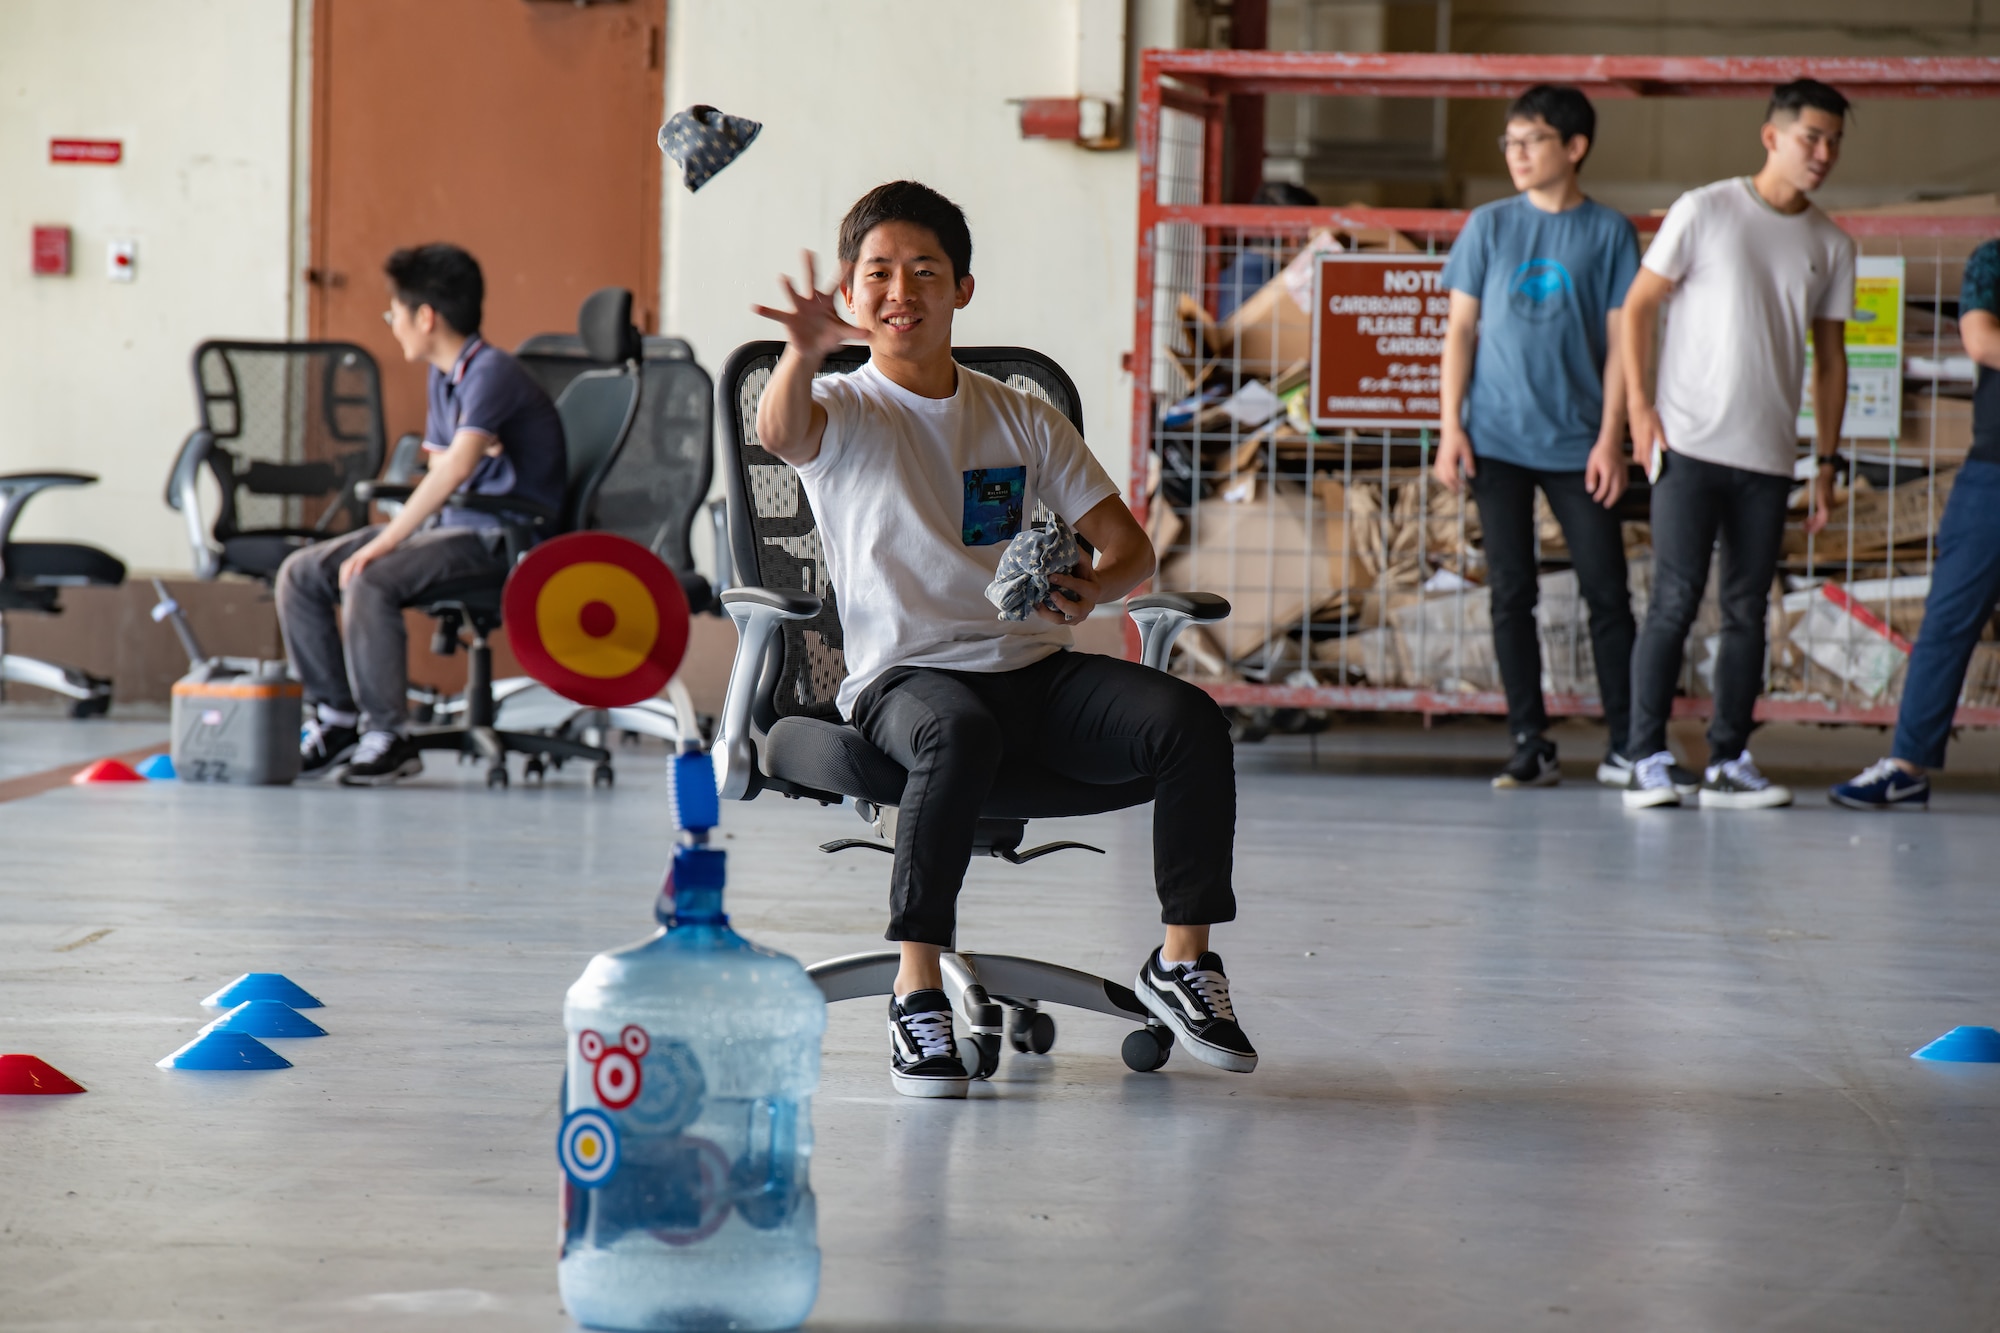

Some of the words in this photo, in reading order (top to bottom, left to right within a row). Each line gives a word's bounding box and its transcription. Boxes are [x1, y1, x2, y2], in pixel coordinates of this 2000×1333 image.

[1384, 269, 1445, 293] NOTI
[1329, 295, 1422, 315] CARDBOARD
[1426, 296, 1450, 315] BO
[1357, 316, 1416, 335] PLEASE
[1420, 317, 1448, 335] FLA
